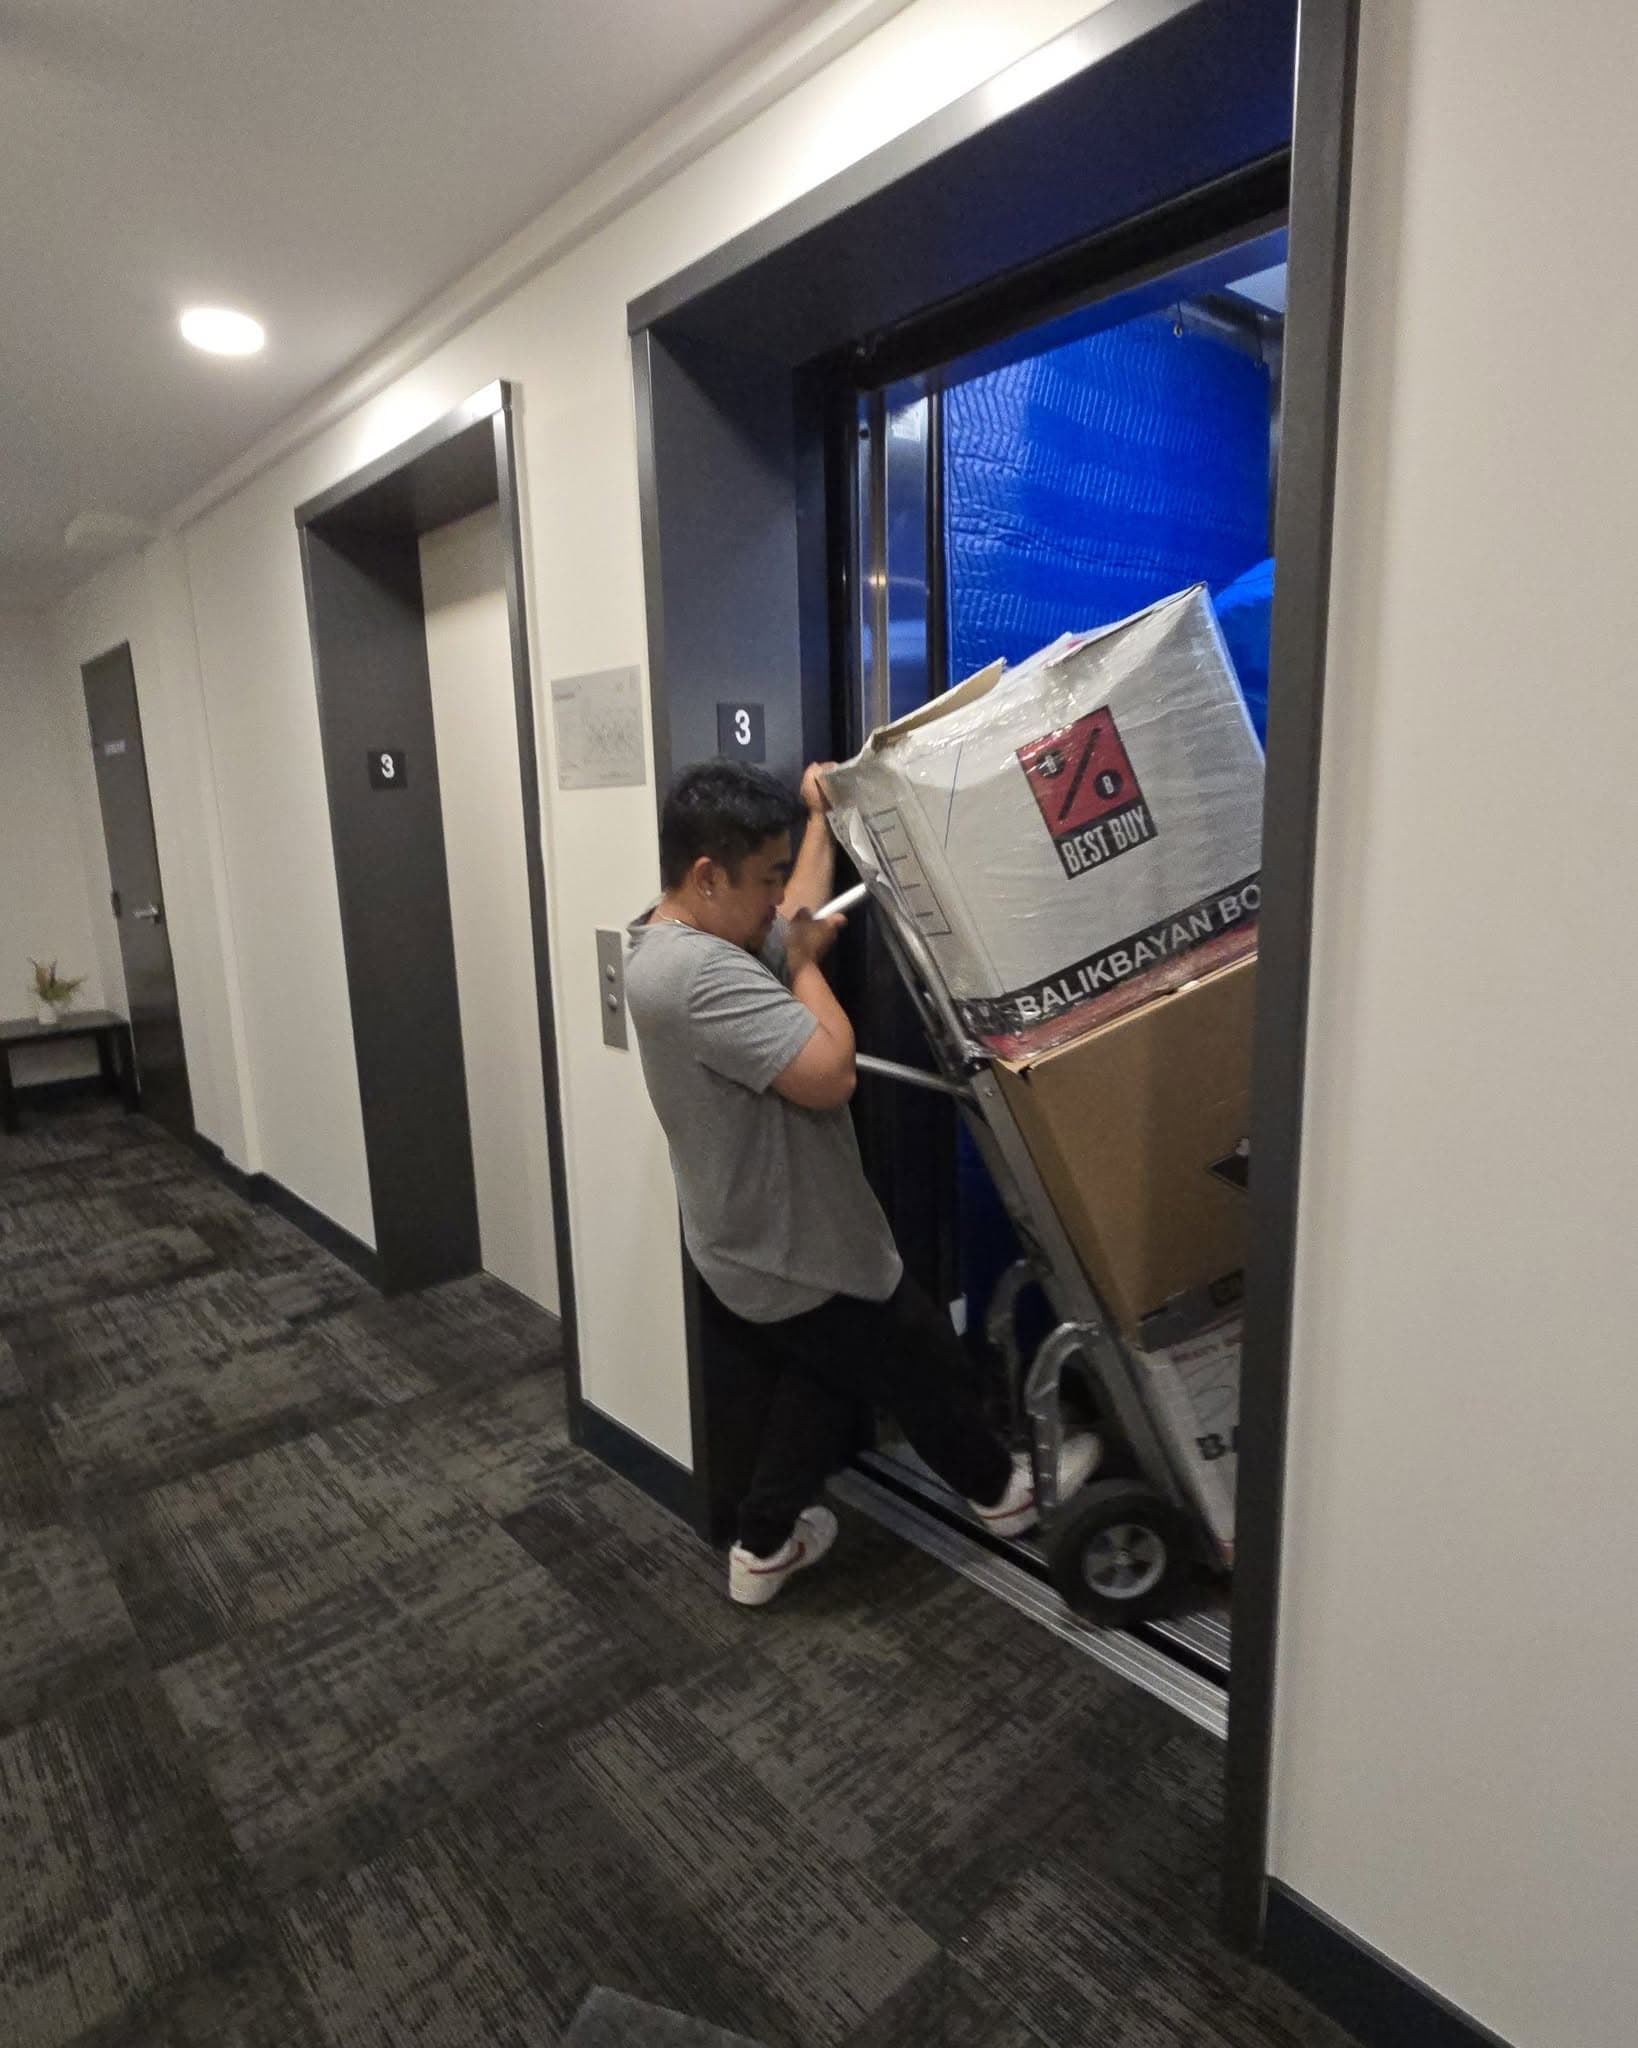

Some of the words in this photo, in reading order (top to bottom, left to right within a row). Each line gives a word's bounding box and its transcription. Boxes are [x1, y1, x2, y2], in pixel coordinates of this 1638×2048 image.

[735, 708, 751, 746] 3
[380, 753, 396, 778] 3
[1061, 825, 1110, 874] BEST
[1107, 805, 1150, 851] BUY
[1014, 909, 1214, 1021] BALIKBAYAN
[1218, 883, 1262, 925] BO
